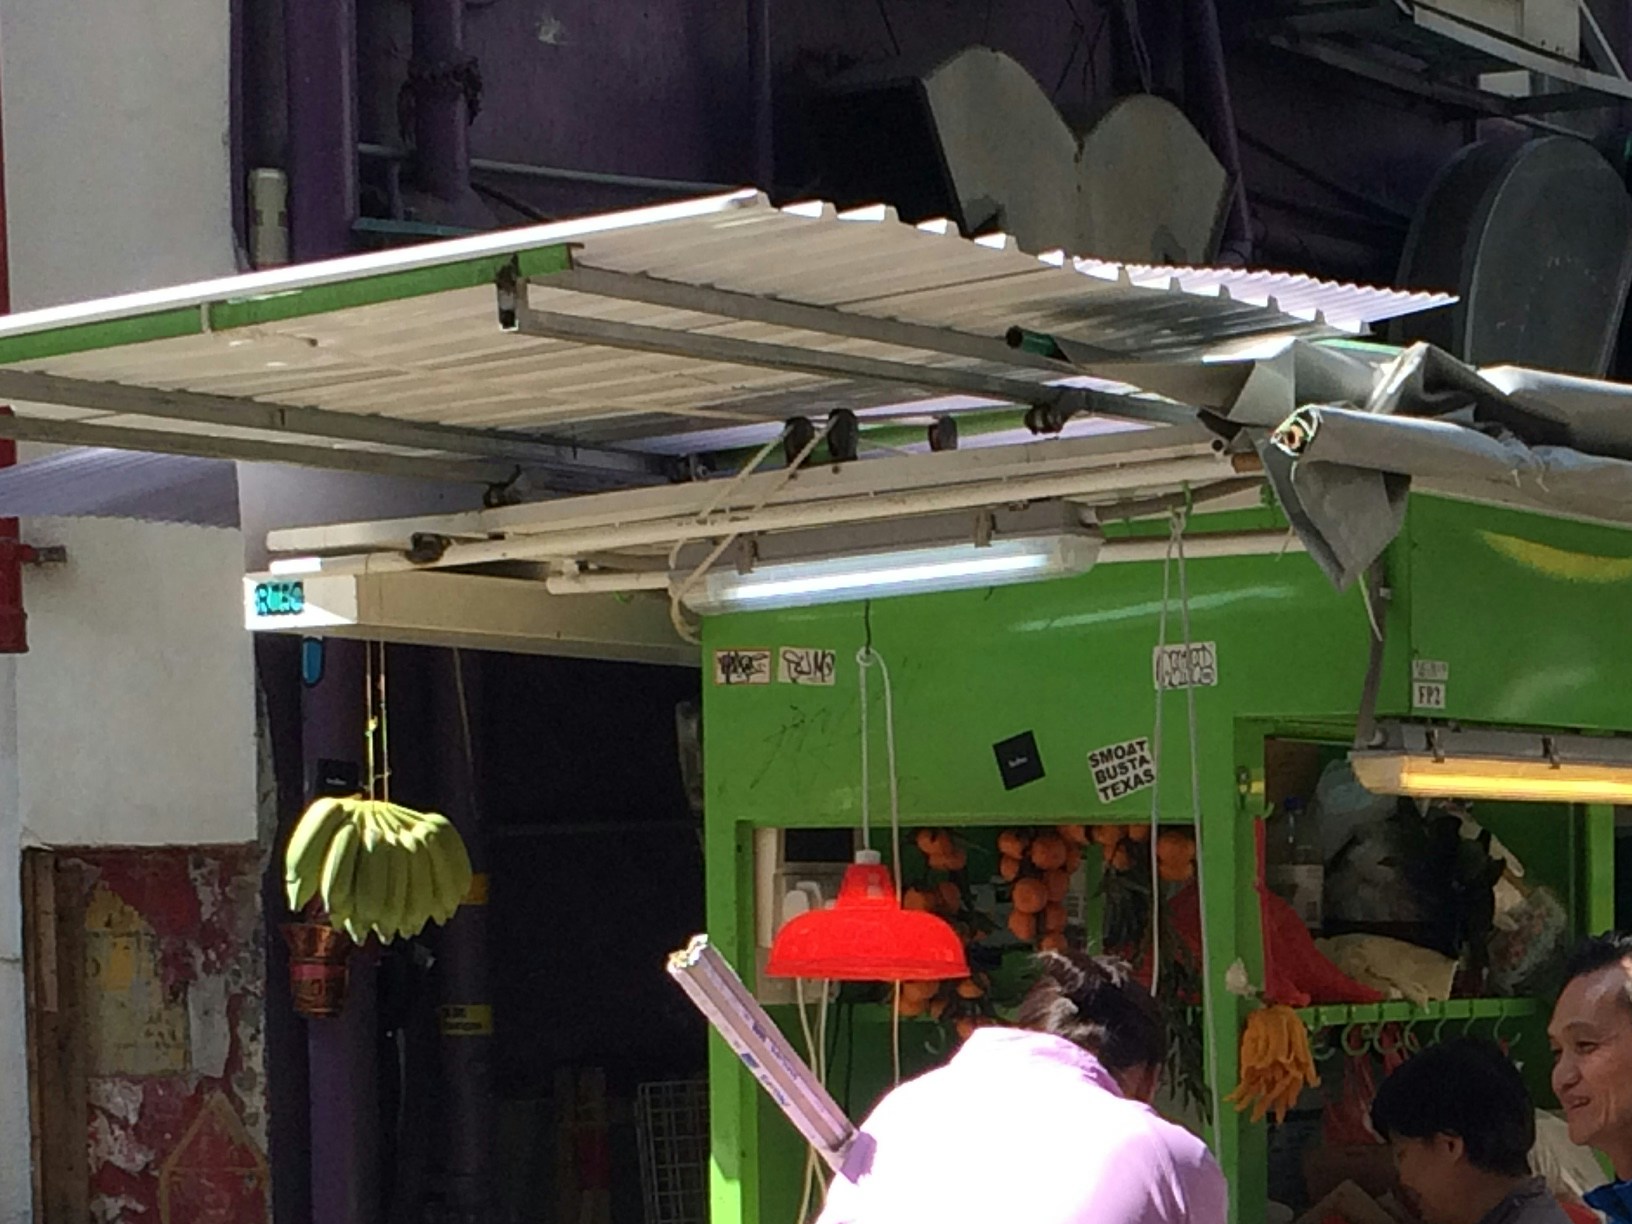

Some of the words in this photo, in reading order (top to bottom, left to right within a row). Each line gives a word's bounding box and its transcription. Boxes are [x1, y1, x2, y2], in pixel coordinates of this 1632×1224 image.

[1088, 739, 1148, 769] SMOAT
[1094, 754, 1151, 786] BUSTA
[1099, 769, 1155, 802] TEXAS
